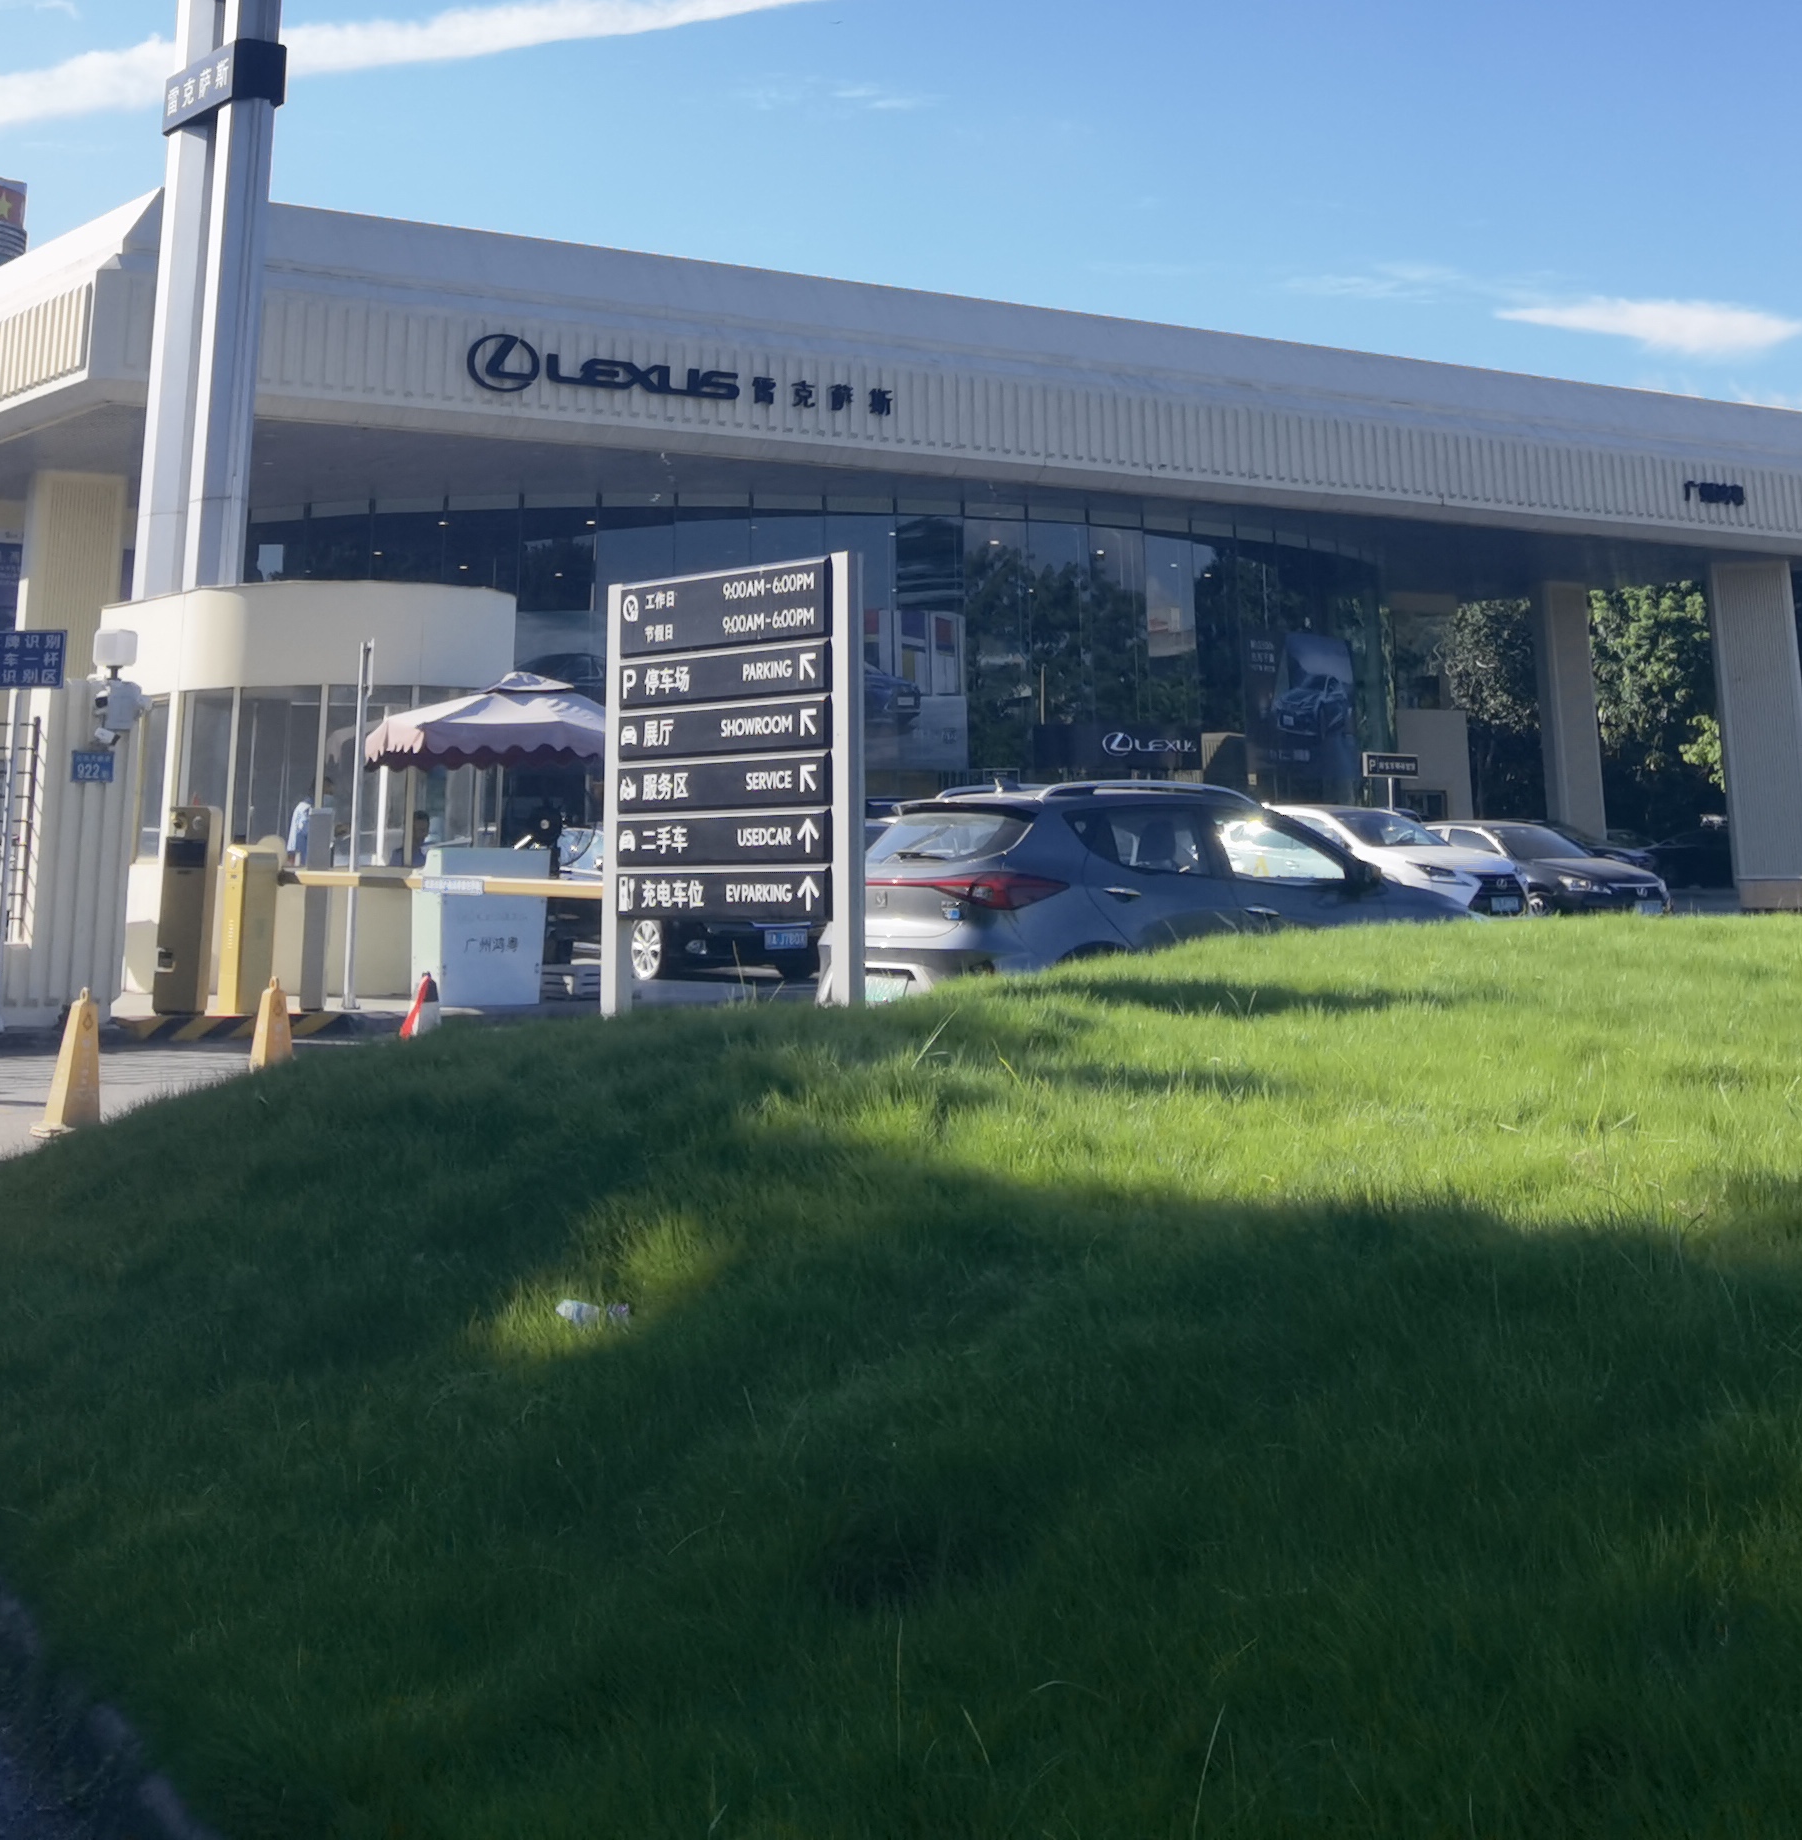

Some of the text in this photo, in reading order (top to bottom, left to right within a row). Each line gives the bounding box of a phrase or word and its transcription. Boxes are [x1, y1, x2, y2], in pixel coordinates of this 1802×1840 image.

[167, 58, 229, 117] 雷克萨斯
[546, 353, 740, 400] LEXUS
[752, 376, 894, 417] 雷克萨斯
[644, 592, 676, 610] 工作日
[644, 622, 675, 642] 节假日
[644, 667, 691, 696] 停车场
[742, 659, 793, 681] PARKING
[643, 719, 675, 748] 展厅
[720, 714, 793, 738] SHOWROOM
[642, 772, 689, 802] 服务区
[745, 769, 792, 792] SERVICE
[641, 825, 688, 855] 二手车
[641, 879, 704, 909] 充电车位
